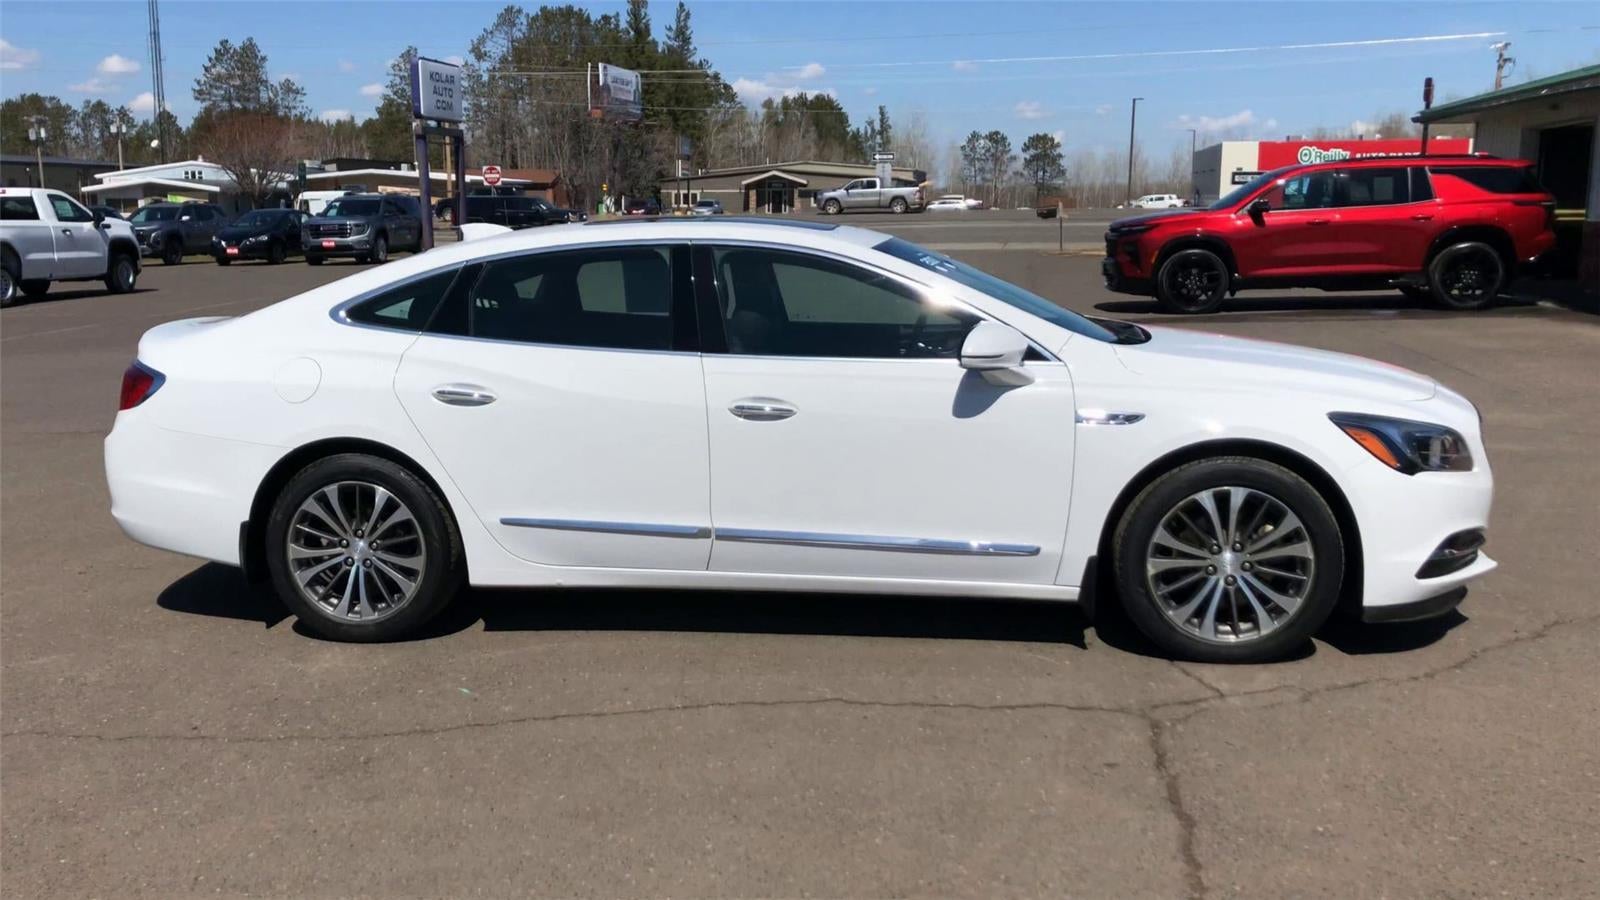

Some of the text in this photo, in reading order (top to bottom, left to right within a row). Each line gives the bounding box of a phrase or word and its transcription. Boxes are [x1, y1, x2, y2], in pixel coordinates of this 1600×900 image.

[429, 71, 455, 86] KOLAR
[432, 85, 454, 99] AUTO
[434, 99, 454, 111] .COM
[1299, 147, 1350, 164] O'Reilly
